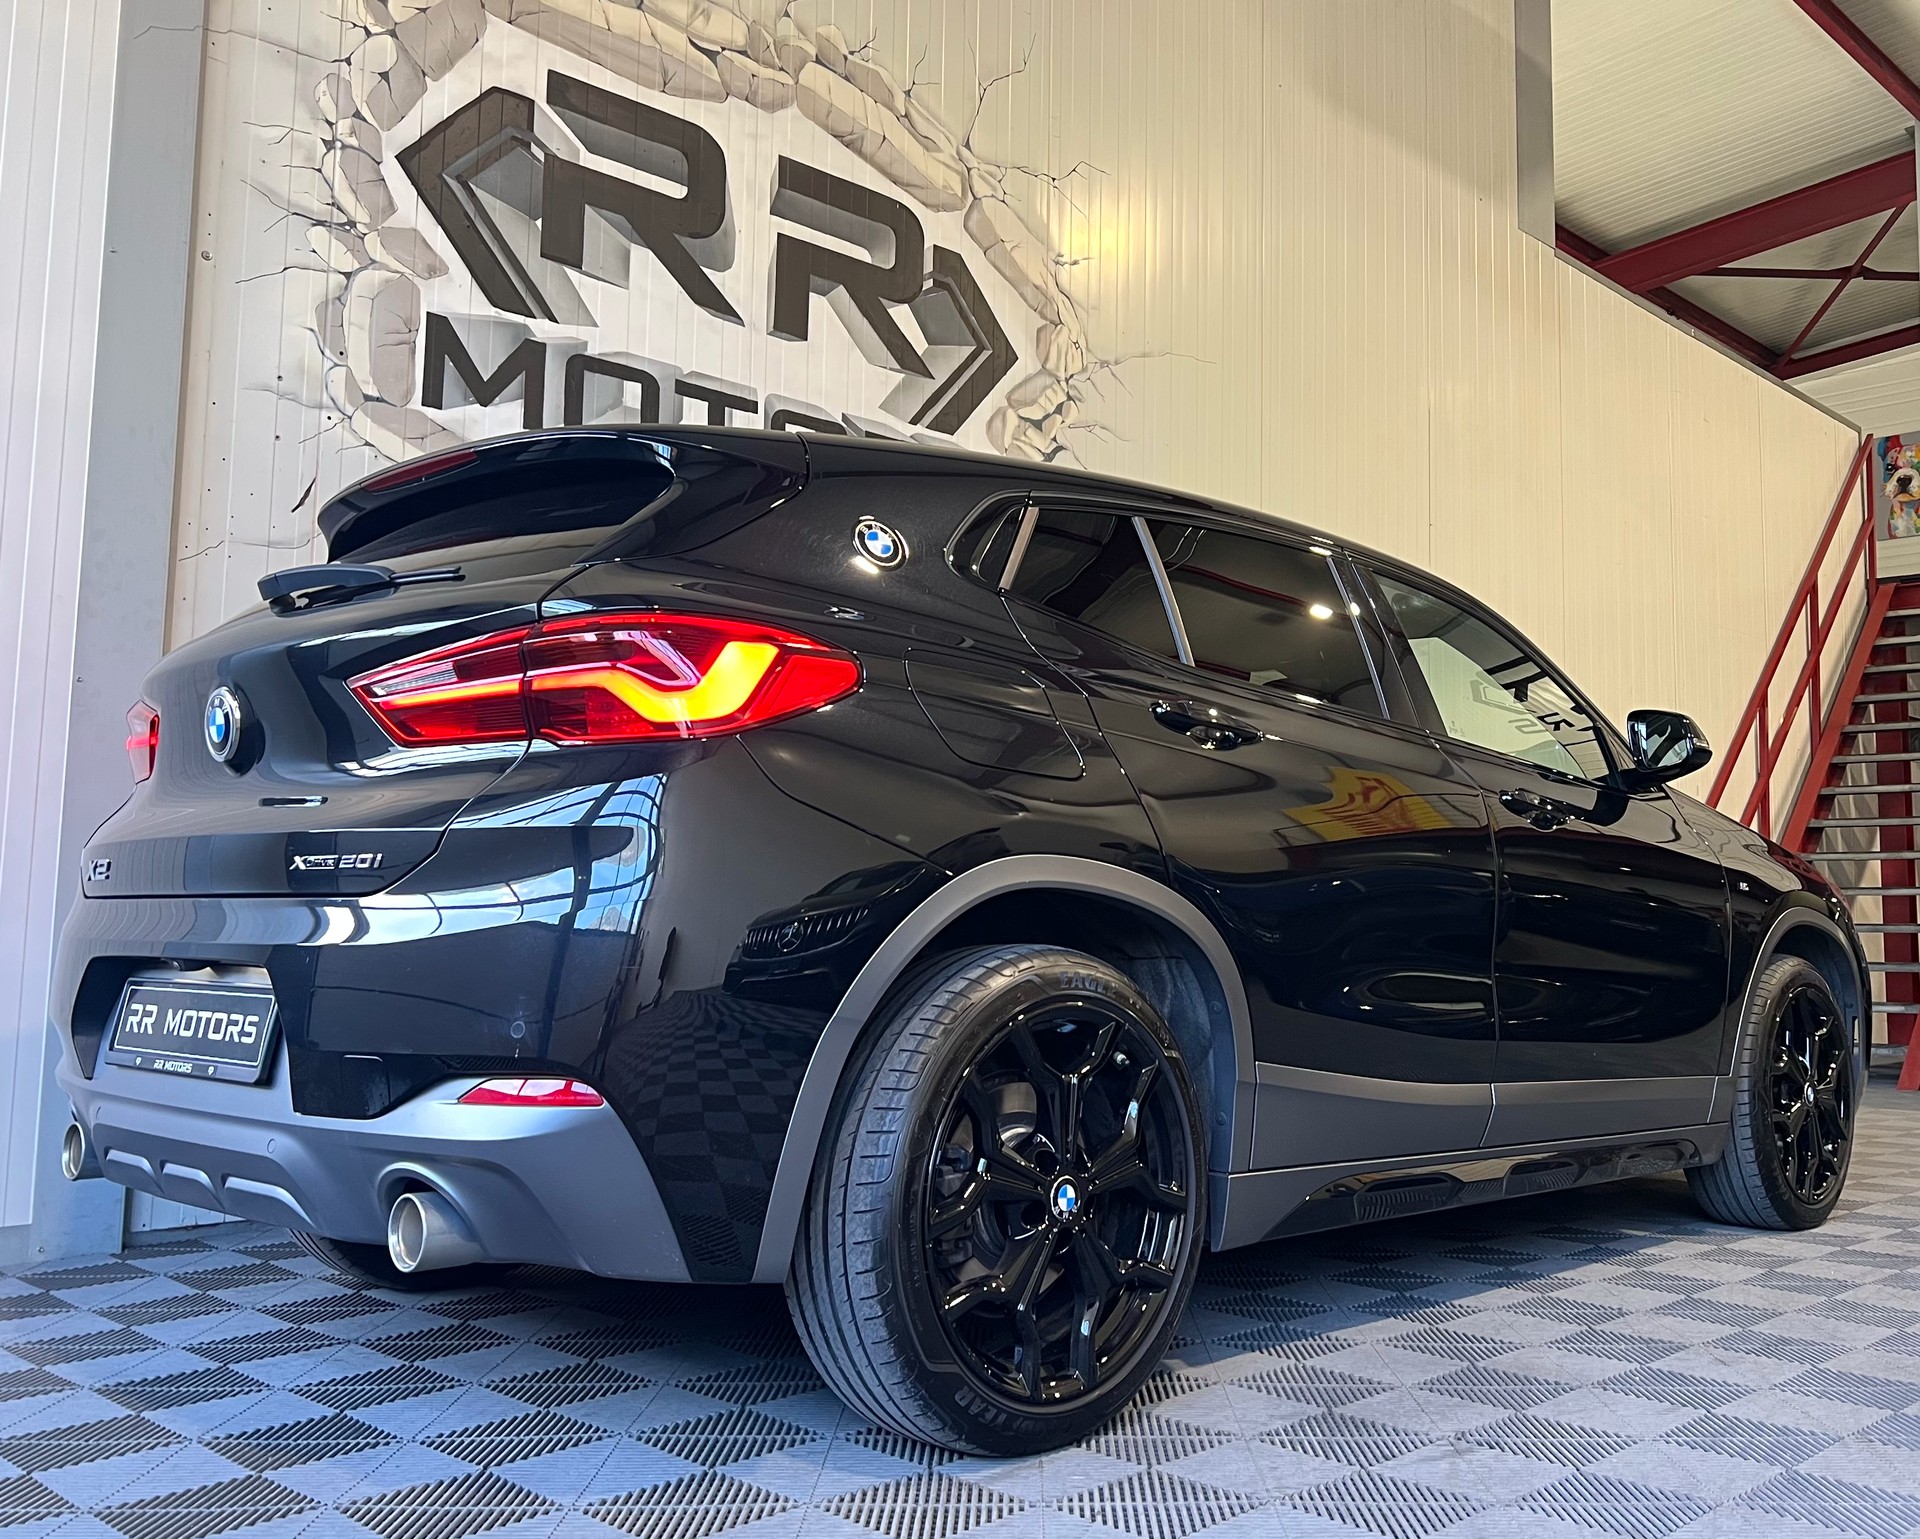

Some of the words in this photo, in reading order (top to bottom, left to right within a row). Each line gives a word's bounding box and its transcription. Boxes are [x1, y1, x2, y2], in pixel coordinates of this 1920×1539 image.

[421, 311, 915, 442] MOT
[86, 859, 111, 881] X2
[125, 1003, 158, 1034] RR
[163, 1008, 260, 1044] MOTORS
[153, 1059, 164, 1070] RR
[163, 1060, 193, 1074] MOTORS
